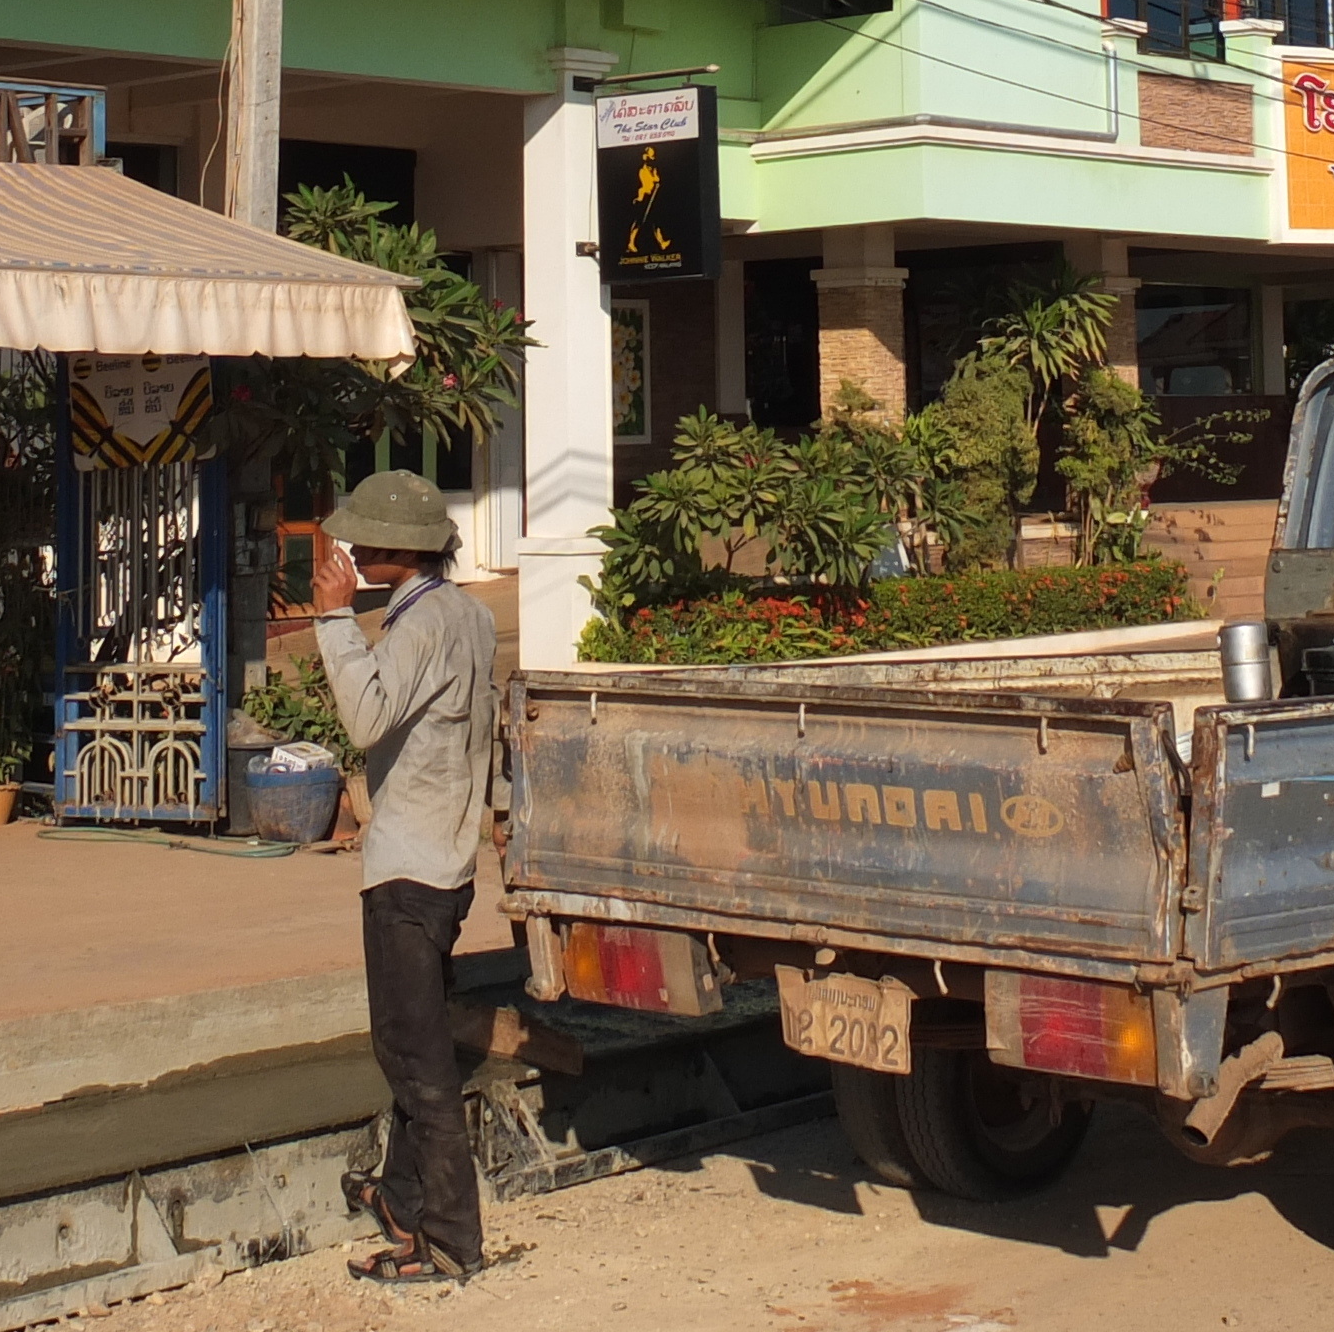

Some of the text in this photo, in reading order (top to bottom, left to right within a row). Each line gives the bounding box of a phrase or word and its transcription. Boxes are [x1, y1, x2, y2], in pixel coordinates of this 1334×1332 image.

[613, 116, 688, 135] The Star Club
[650, 253, 682, 263] WALKER
[741, 777, 988, 834] HYUNDAI
